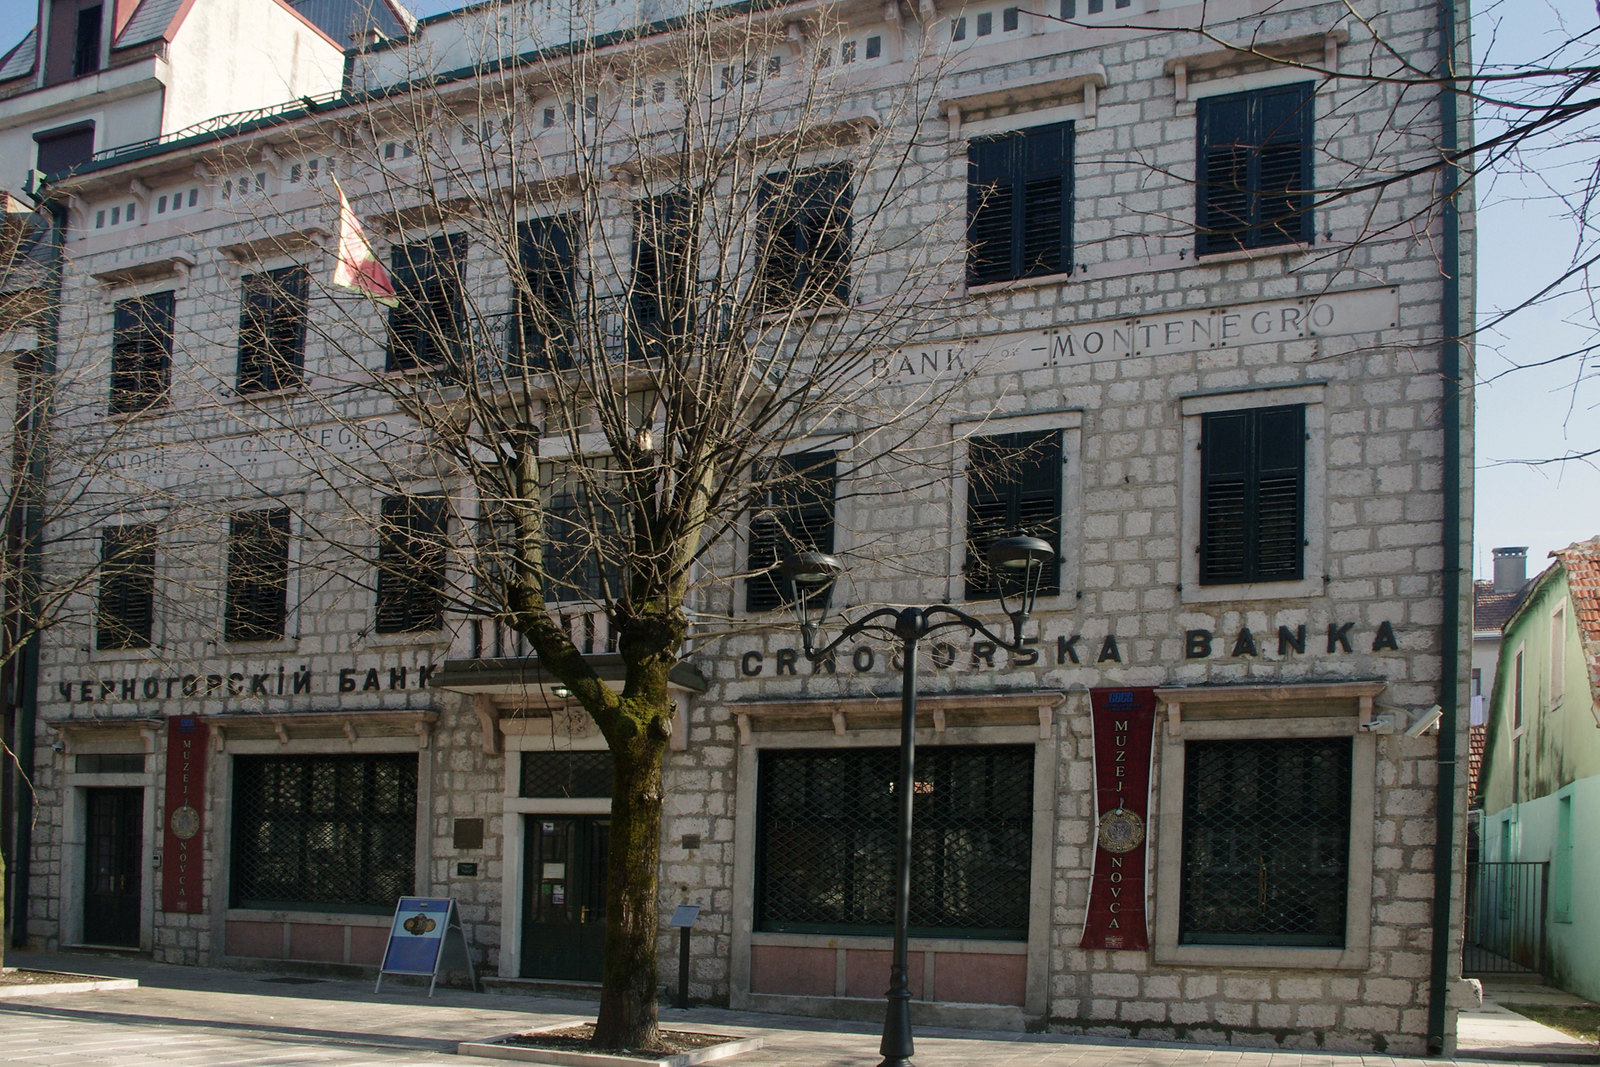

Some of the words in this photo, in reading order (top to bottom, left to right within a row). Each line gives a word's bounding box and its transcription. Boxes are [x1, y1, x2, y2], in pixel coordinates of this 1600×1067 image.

[872, 349, 965, 379] BANK
[1052, 303, 1335, 359] MONTENEGRO
[1185, 620, 1399, 660] BANKA
[183, 739, 191, 794] MUZEJ
[1115, 719, 1128, 793] MUZEJ
[1108, 856, 1123, 930] NOVCA
